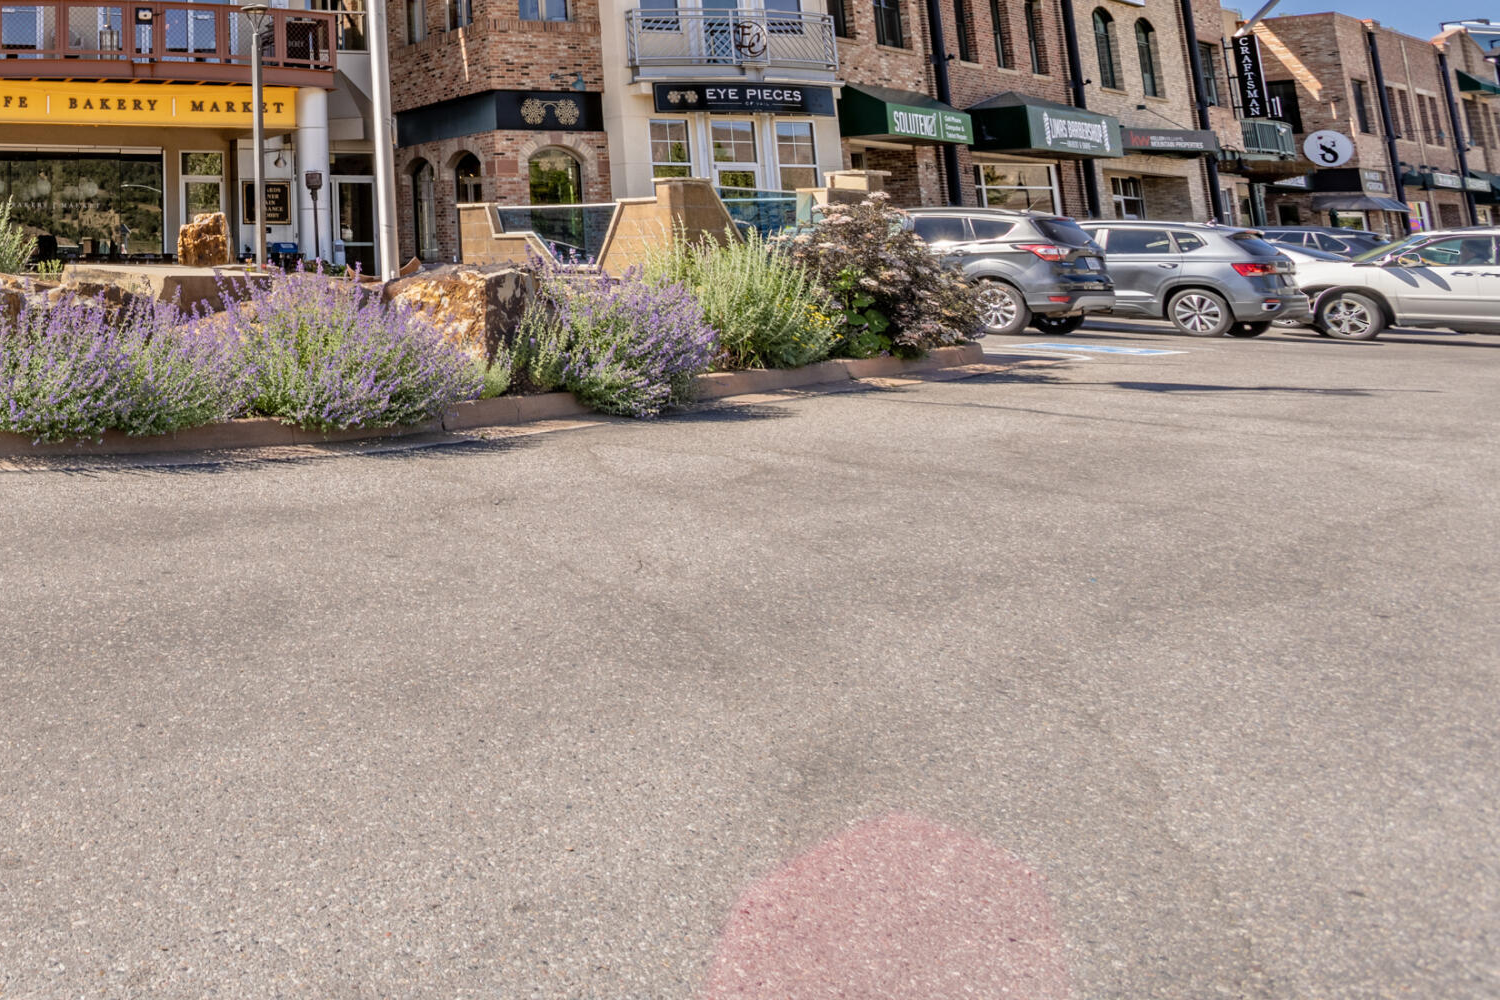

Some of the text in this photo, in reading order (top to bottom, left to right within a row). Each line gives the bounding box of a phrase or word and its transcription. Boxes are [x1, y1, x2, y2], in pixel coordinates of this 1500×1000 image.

[1238, 37, 1261, 116] CRAFTSMAN
[705, 87, 802, 102] EYE PIECES
[68, 97, 159, 112] BAKERY
[191, 100, 284, 114] MARKET
[1130, 130, 1150, 147] kw
[1176, 141, 1204, 149] PROPERTIES
